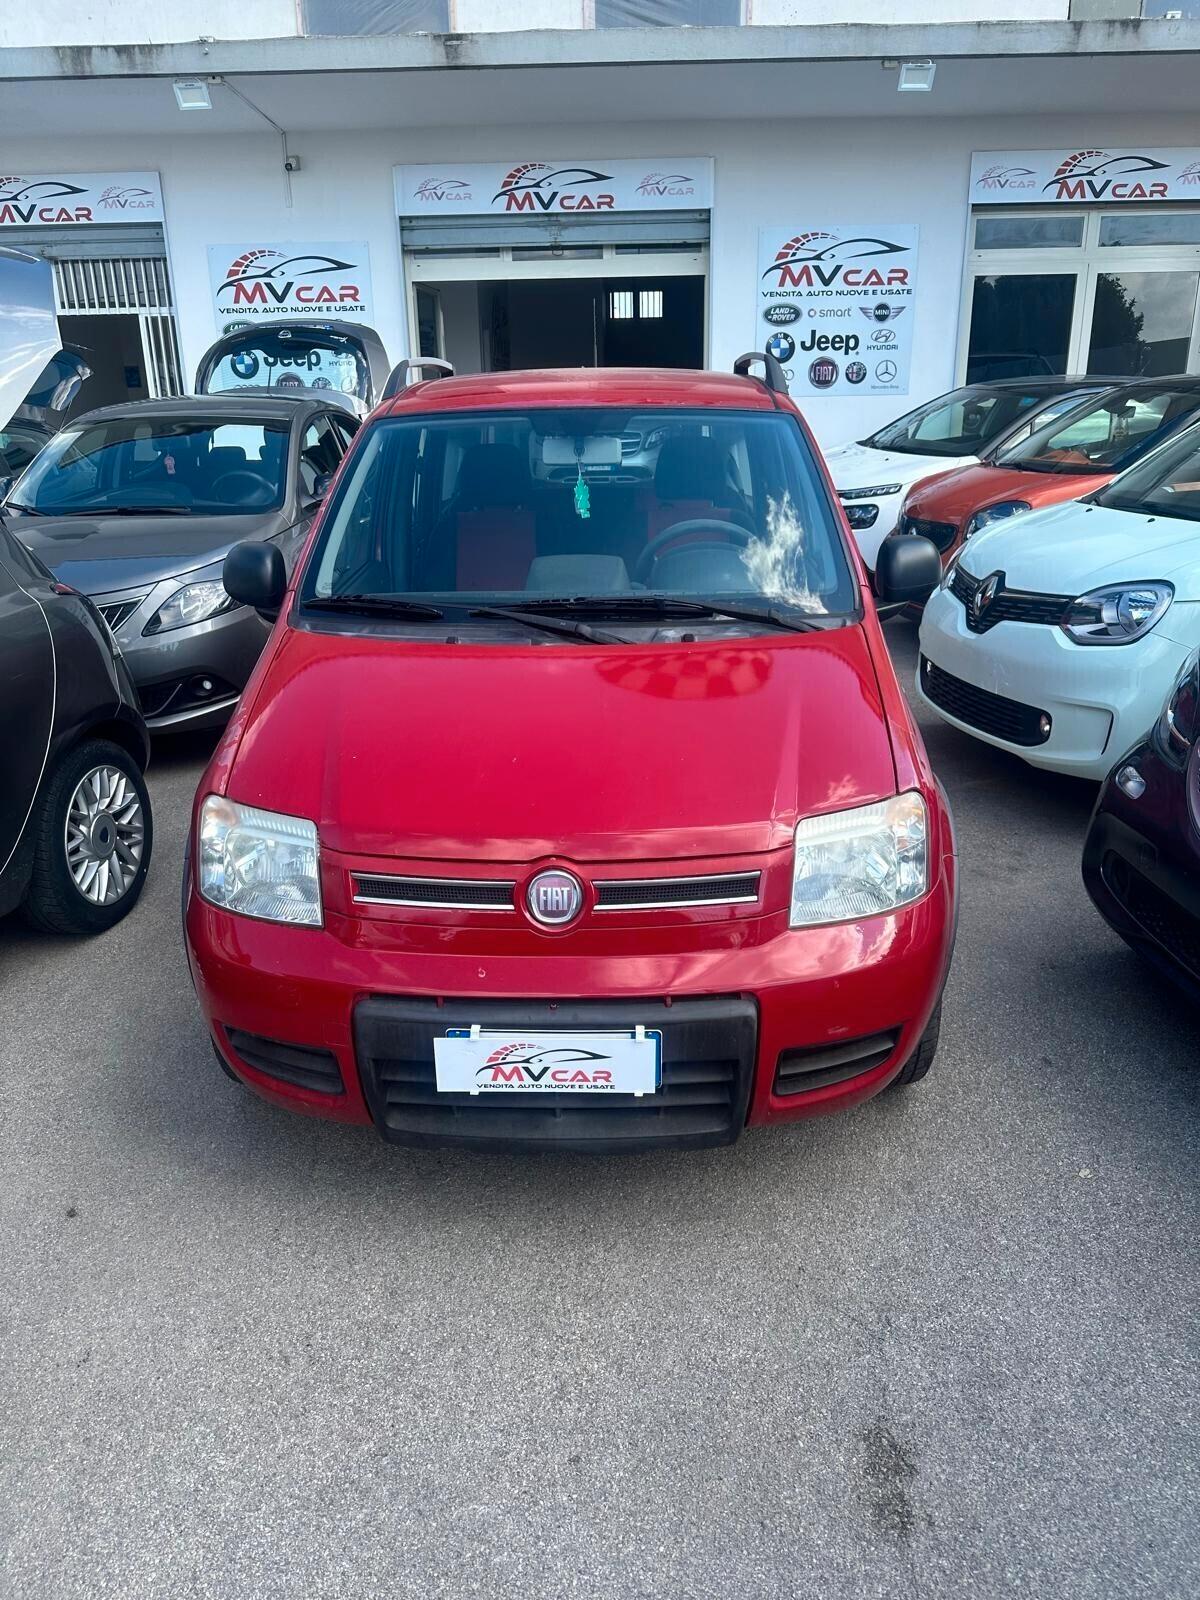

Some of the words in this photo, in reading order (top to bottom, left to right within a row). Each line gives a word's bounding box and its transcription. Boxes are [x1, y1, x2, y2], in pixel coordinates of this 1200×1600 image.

[761, 290, 803, 298] VENDITA
[806, 289, 833, 297] AUTO
[261, 306, 289, 314] AUTO
[818, 307, 852, 318] smart
[800, 329, 860, 355] Jeep
[815, 365, 833, 381] FIAT
[540, 887, 570, 911] FIAT
